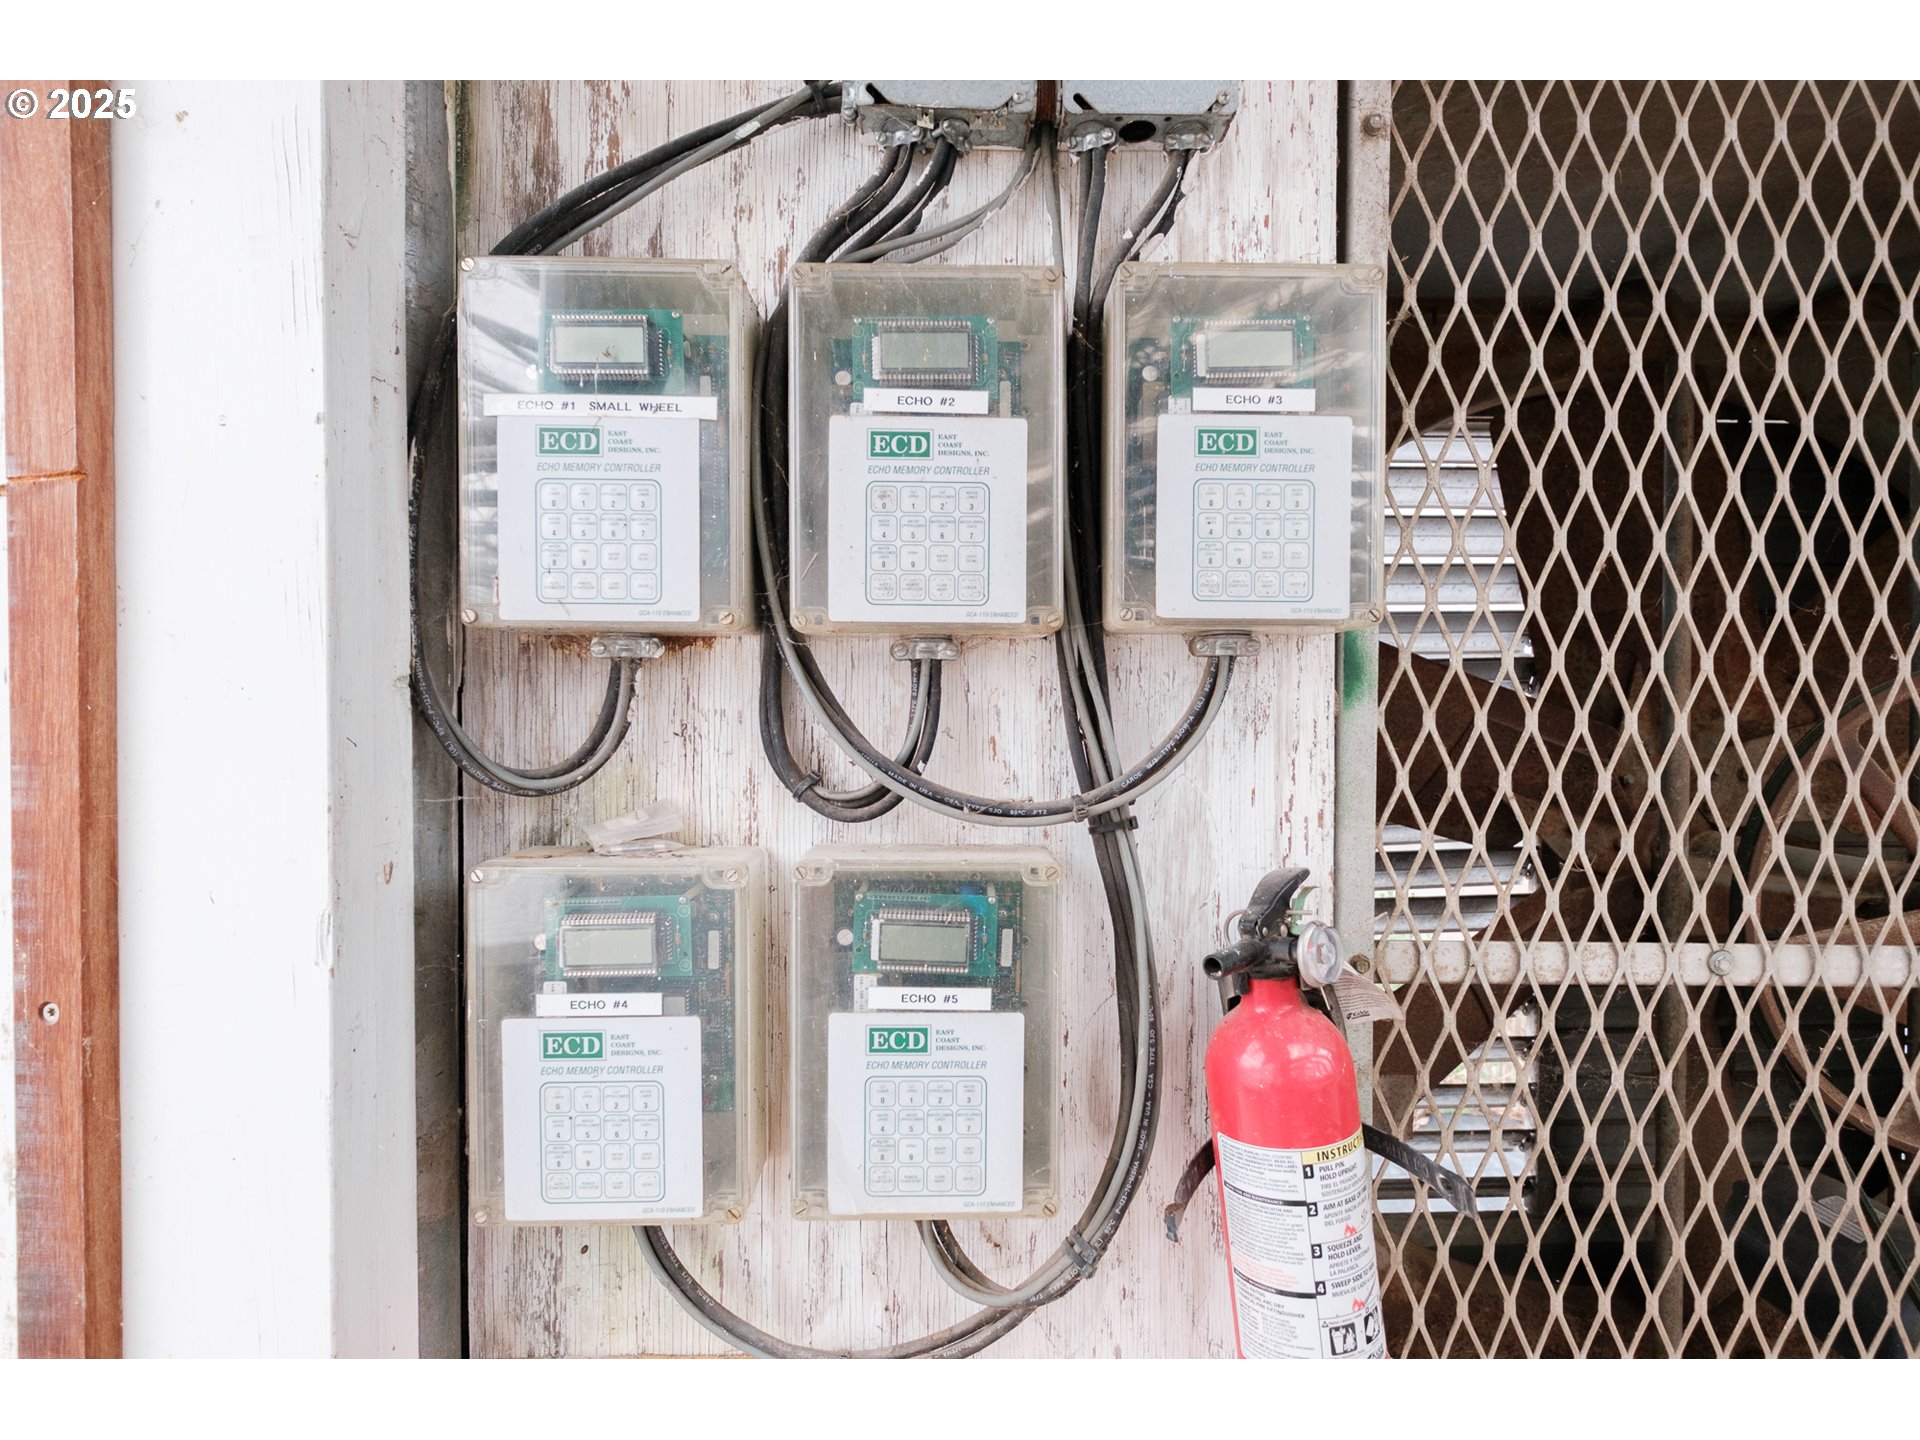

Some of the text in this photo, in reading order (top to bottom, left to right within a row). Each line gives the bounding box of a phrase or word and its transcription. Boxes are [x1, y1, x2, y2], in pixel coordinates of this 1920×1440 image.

[897, 397, 955, 406] ECHO #2
[1226, 395, 1282, 404] ECHO #3
[517, 400, 683, 412] ECHO #1 SMALL WHEEL
[541, 431, 597, 450] ECD
[873, 435, 927, 454] ECD
[1200, 433, 1254, 451] ECD
[536, 462, 661, 473] ECHO MEMORY CONTROLLER
[868, 465, 990, 475] ECHO MEMORY CONTROLLER
[1195, 463, 1315, 473] ECHO MEMORY CONTROLLER
[1121, 771, 1143, 788] CAROL
[1161, 739, 1176, 757] TYPE
[1174, 714, 1196, 743] SJOW-A
[1194, 696, 1206, 711] (UL)
[887, 770, 933, 798] MADE IN USA
[944, 797, 959, 806] CSA
[965, 803, 985, 812] TYPE
[988, 807, 1002, 815] SJO
[570, 1000, 628, 1010] ECHO #4
[901, 994, 958, 1004] ECHO #5
[545, 1037, 600, 1055] ECD
[871, 1031, 926, 1049] ECD
[541, 1065, 663, 1076] ECHO MEMORY CONTROLLER
[866, 1061, 987, 1070] ECHO MEMORY CONTROLLER
[1142, 1118, 1149, 1128] IN
[1138, 1129, 1148, 1152] MADE
[1305, 1166, 1312, 1177] 1
[1319, 1161, 1345, 1173] PULL PIN
[1320, 1162, 1357, 1182] HOLD UPRIGHT
[1309, 1205, 1317, 1215] 2
[1323, 1202, 1336, 1211] AIM
[1337, 1200, 1344, 1208] AT
[1312, 1246, 1321, 1256] 3
[1327, 1239, 1352, 1253] SQUEEZE
[1328, 1243, 1362, 1261] HOLD LEVER
[667, 1251, 680, 1267] TYPE
[1316, 1283, 1325, 1293] 4
[1330, 1276, 1352, 1289] SWEEP
[696, 1286, 715, 1306] CAROL
